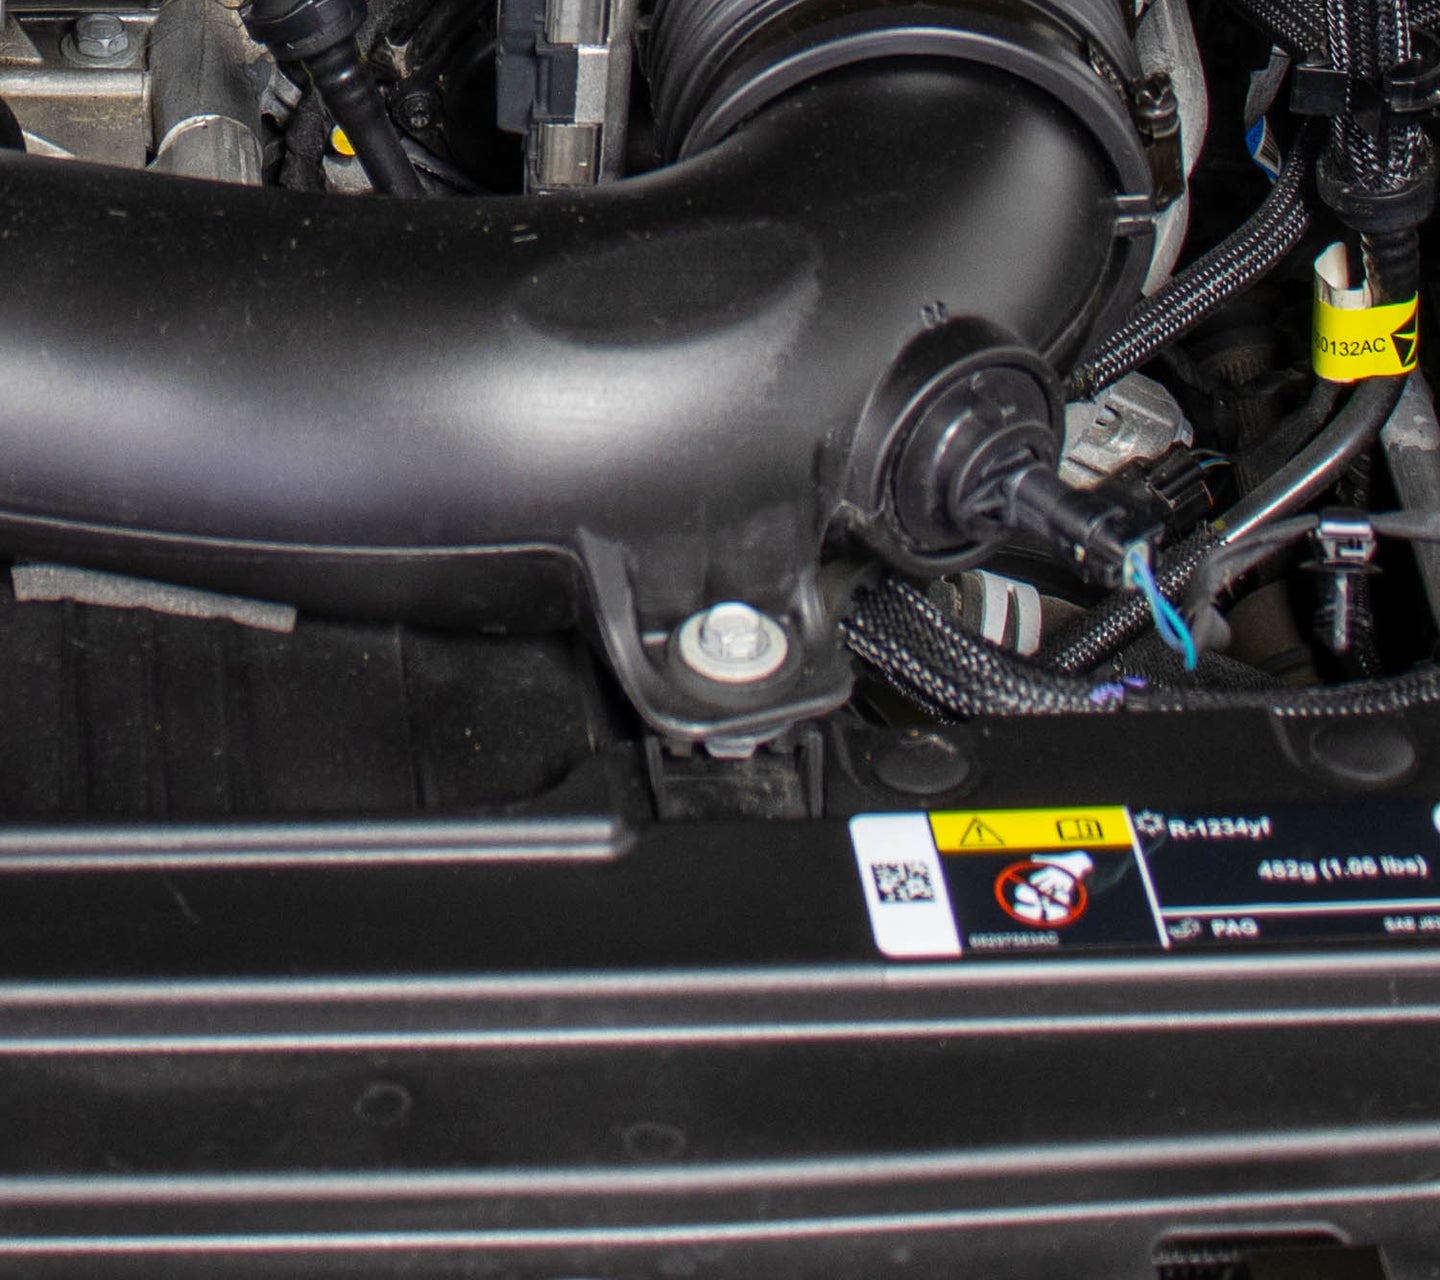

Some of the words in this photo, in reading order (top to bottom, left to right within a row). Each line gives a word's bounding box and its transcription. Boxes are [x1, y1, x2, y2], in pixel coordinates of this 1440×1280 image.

[1167, 813, 1272, 842] R-1234yf
[1381, 854, 1428, 879] lbs)
[1210, 918, 1260, 939] PAG
